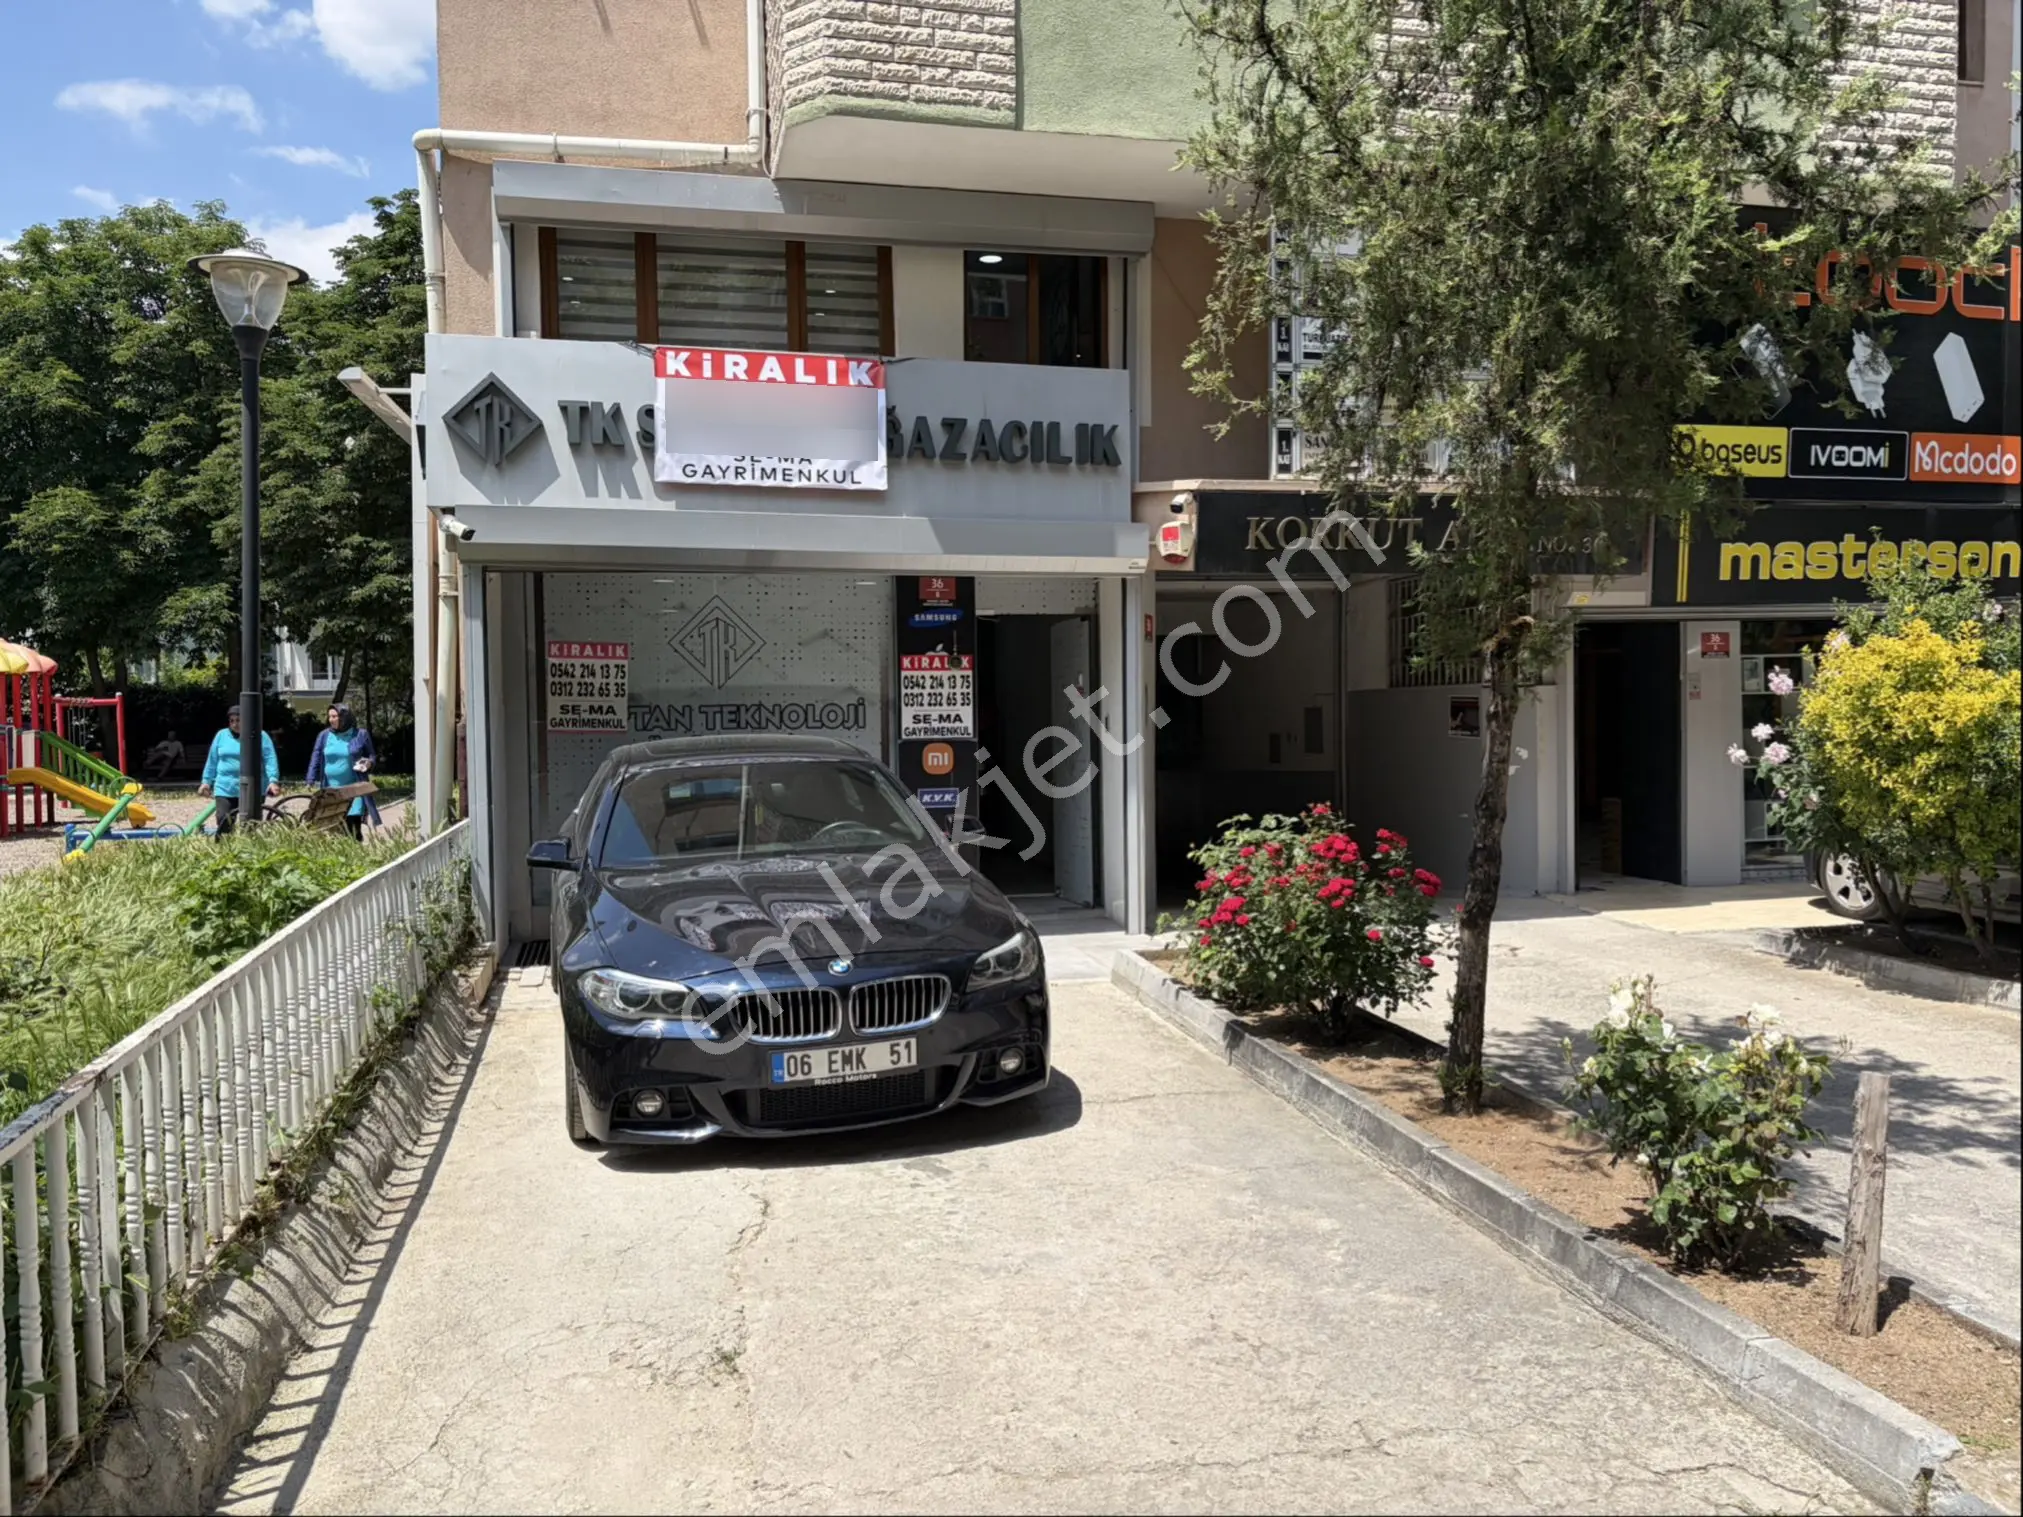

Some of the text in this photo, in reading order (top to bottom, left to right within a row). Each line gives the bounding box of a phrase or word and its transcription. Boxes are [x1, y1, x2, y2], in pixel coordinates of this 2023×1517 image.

[1701, 438, 1782, 465] baseus
[1914, 440, 2017, 476] Mcdodo
[682, 463, 862, 484] GAYRİMENKUL
[1245, 516, 1423, 551] KORKUT
[1719, 534, 2021, 581] masterson
[931, 578, 944, 589] 36
[550, 663, 627, 680] 0542 214 13 75
[550, 682, 627, 698] 0312 232 65 35
[903, 675, 971, 690] 0542 214 13 75
[903, 692, 971, 707] 0312 232 65 35
[550, 716, 626, 729] GAYRİMENKUL
[628, 697, 866, 731] TAN TEKNOLOJİ
[903, 724, 972, 737] GAYRİMENKUL
[786, 1054, 812, 1078] 06
[828, 1047, 867, 1074] EMK
[889, 1040, 912, 1066] 51
[814, 1073, 877, 1086] Rocco Motors
